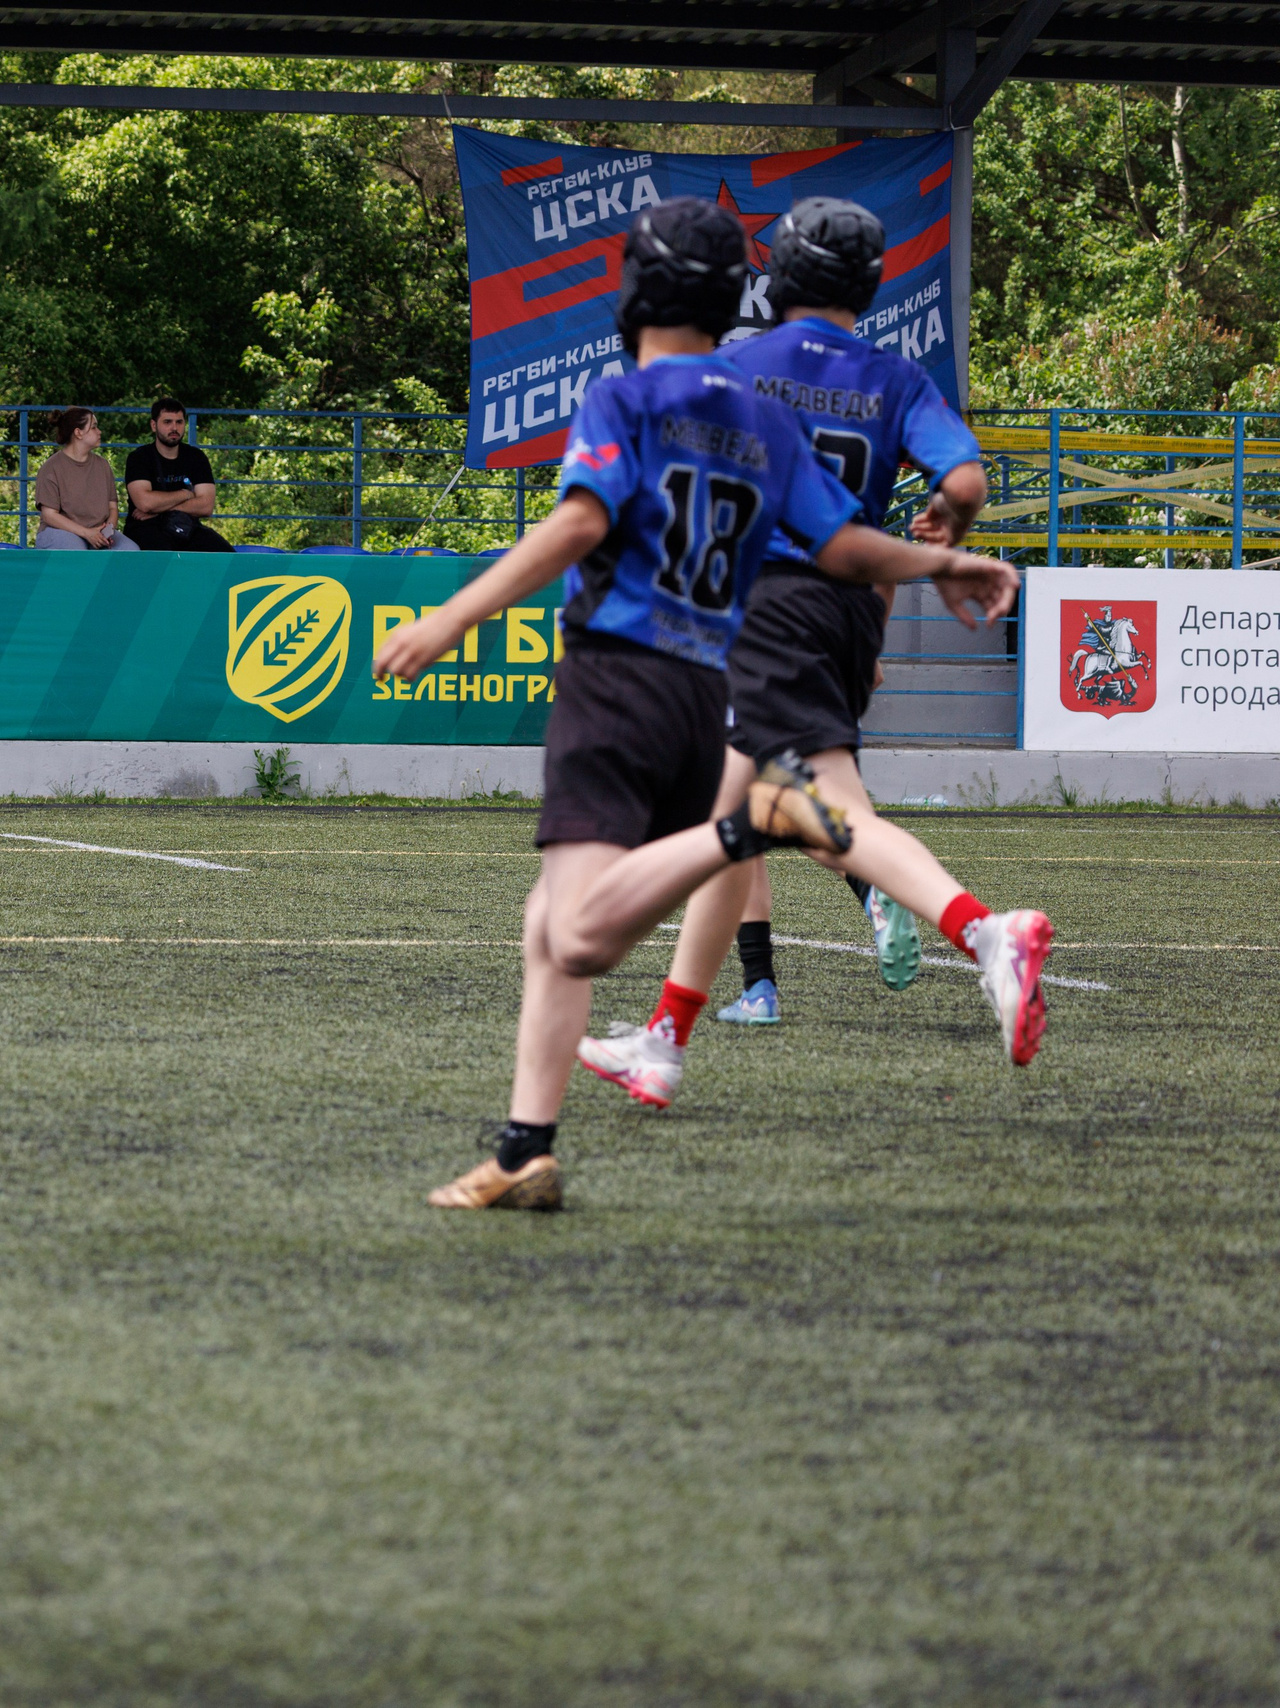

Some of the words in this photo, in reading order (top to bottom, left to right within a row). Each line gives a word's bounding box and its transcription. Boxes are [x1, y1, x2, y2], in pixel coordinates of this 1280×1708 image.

[527, 153, 653, 201] РЕГБИ-КЛУБ
[532, 174, 662, 242] ЦСКА
[853, 278, 941, 339] ЕГБИ-КЛУБ
[753, 375, 884, 422] МЕДВЕДИ
[651, 462, 764, 618] 18
[1181, 648, 1280, 674] спорта
[1181, 686, 1280, 712] города
